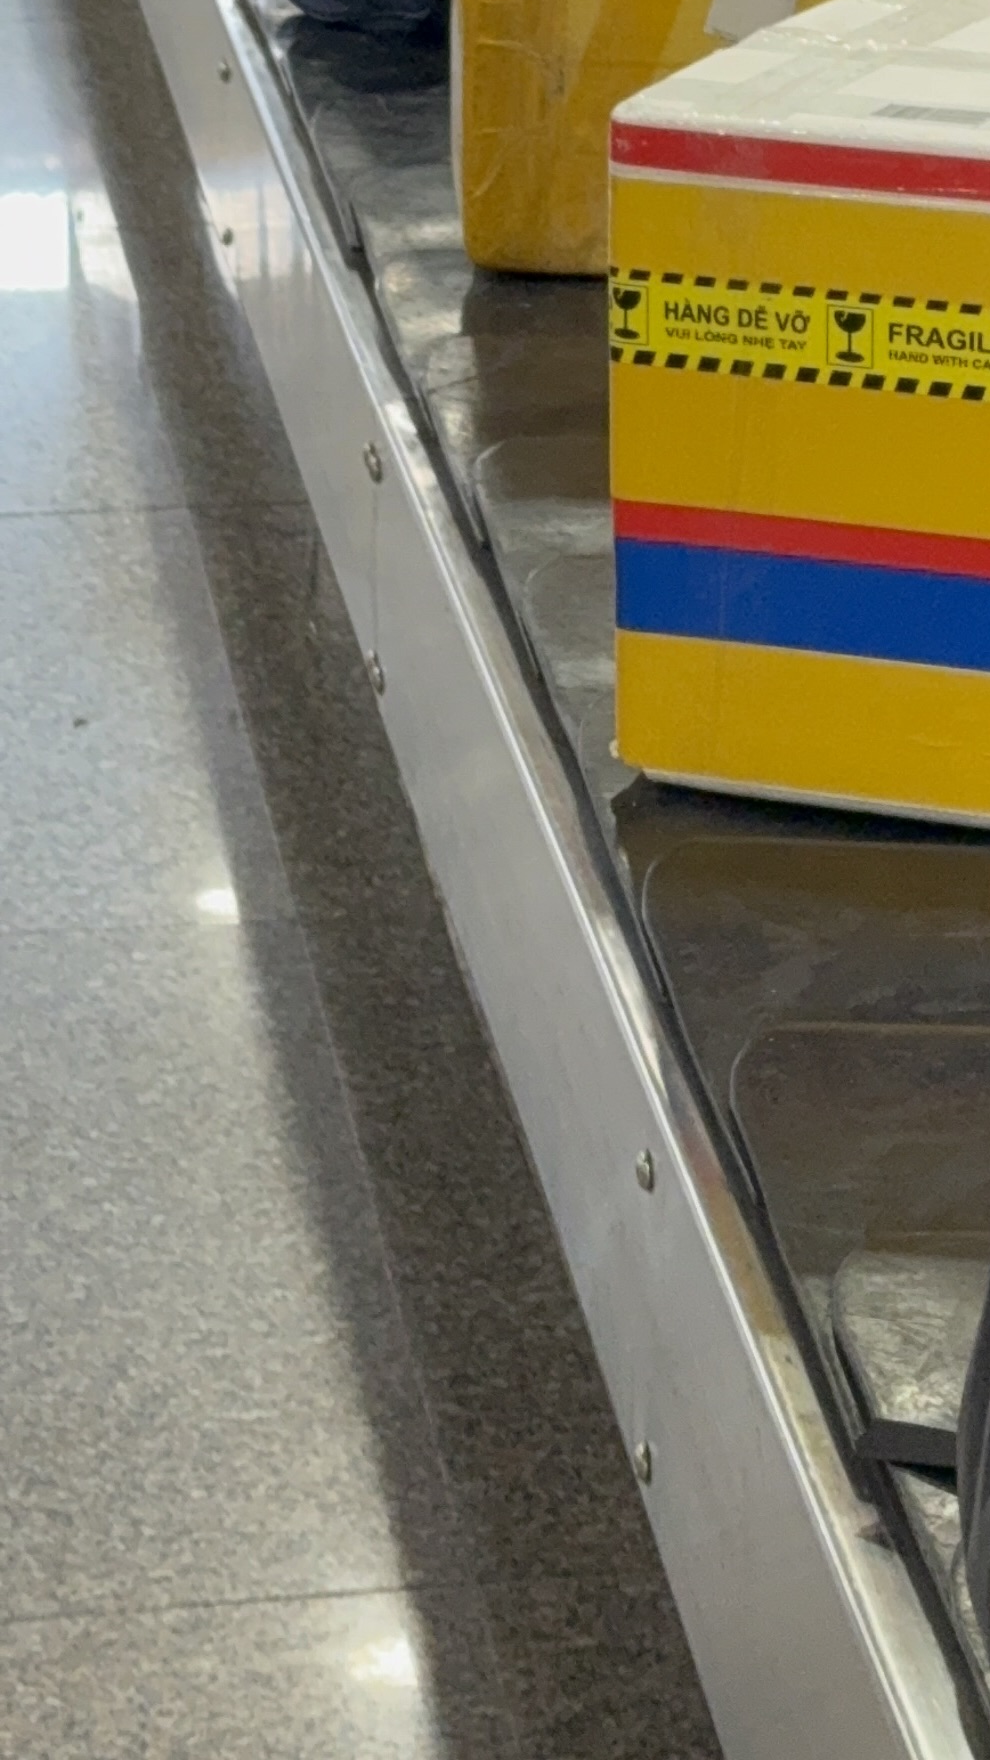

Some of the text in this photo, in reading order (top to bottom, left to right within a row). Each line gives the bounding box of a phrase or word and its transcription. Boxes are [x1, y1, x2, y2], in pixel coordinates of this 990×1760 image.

[664, 298, 810, 334] HÀNG DỄ VỠ
[889, 349, 928, 364] HAND
[933, 354, 968, 368] WITH
